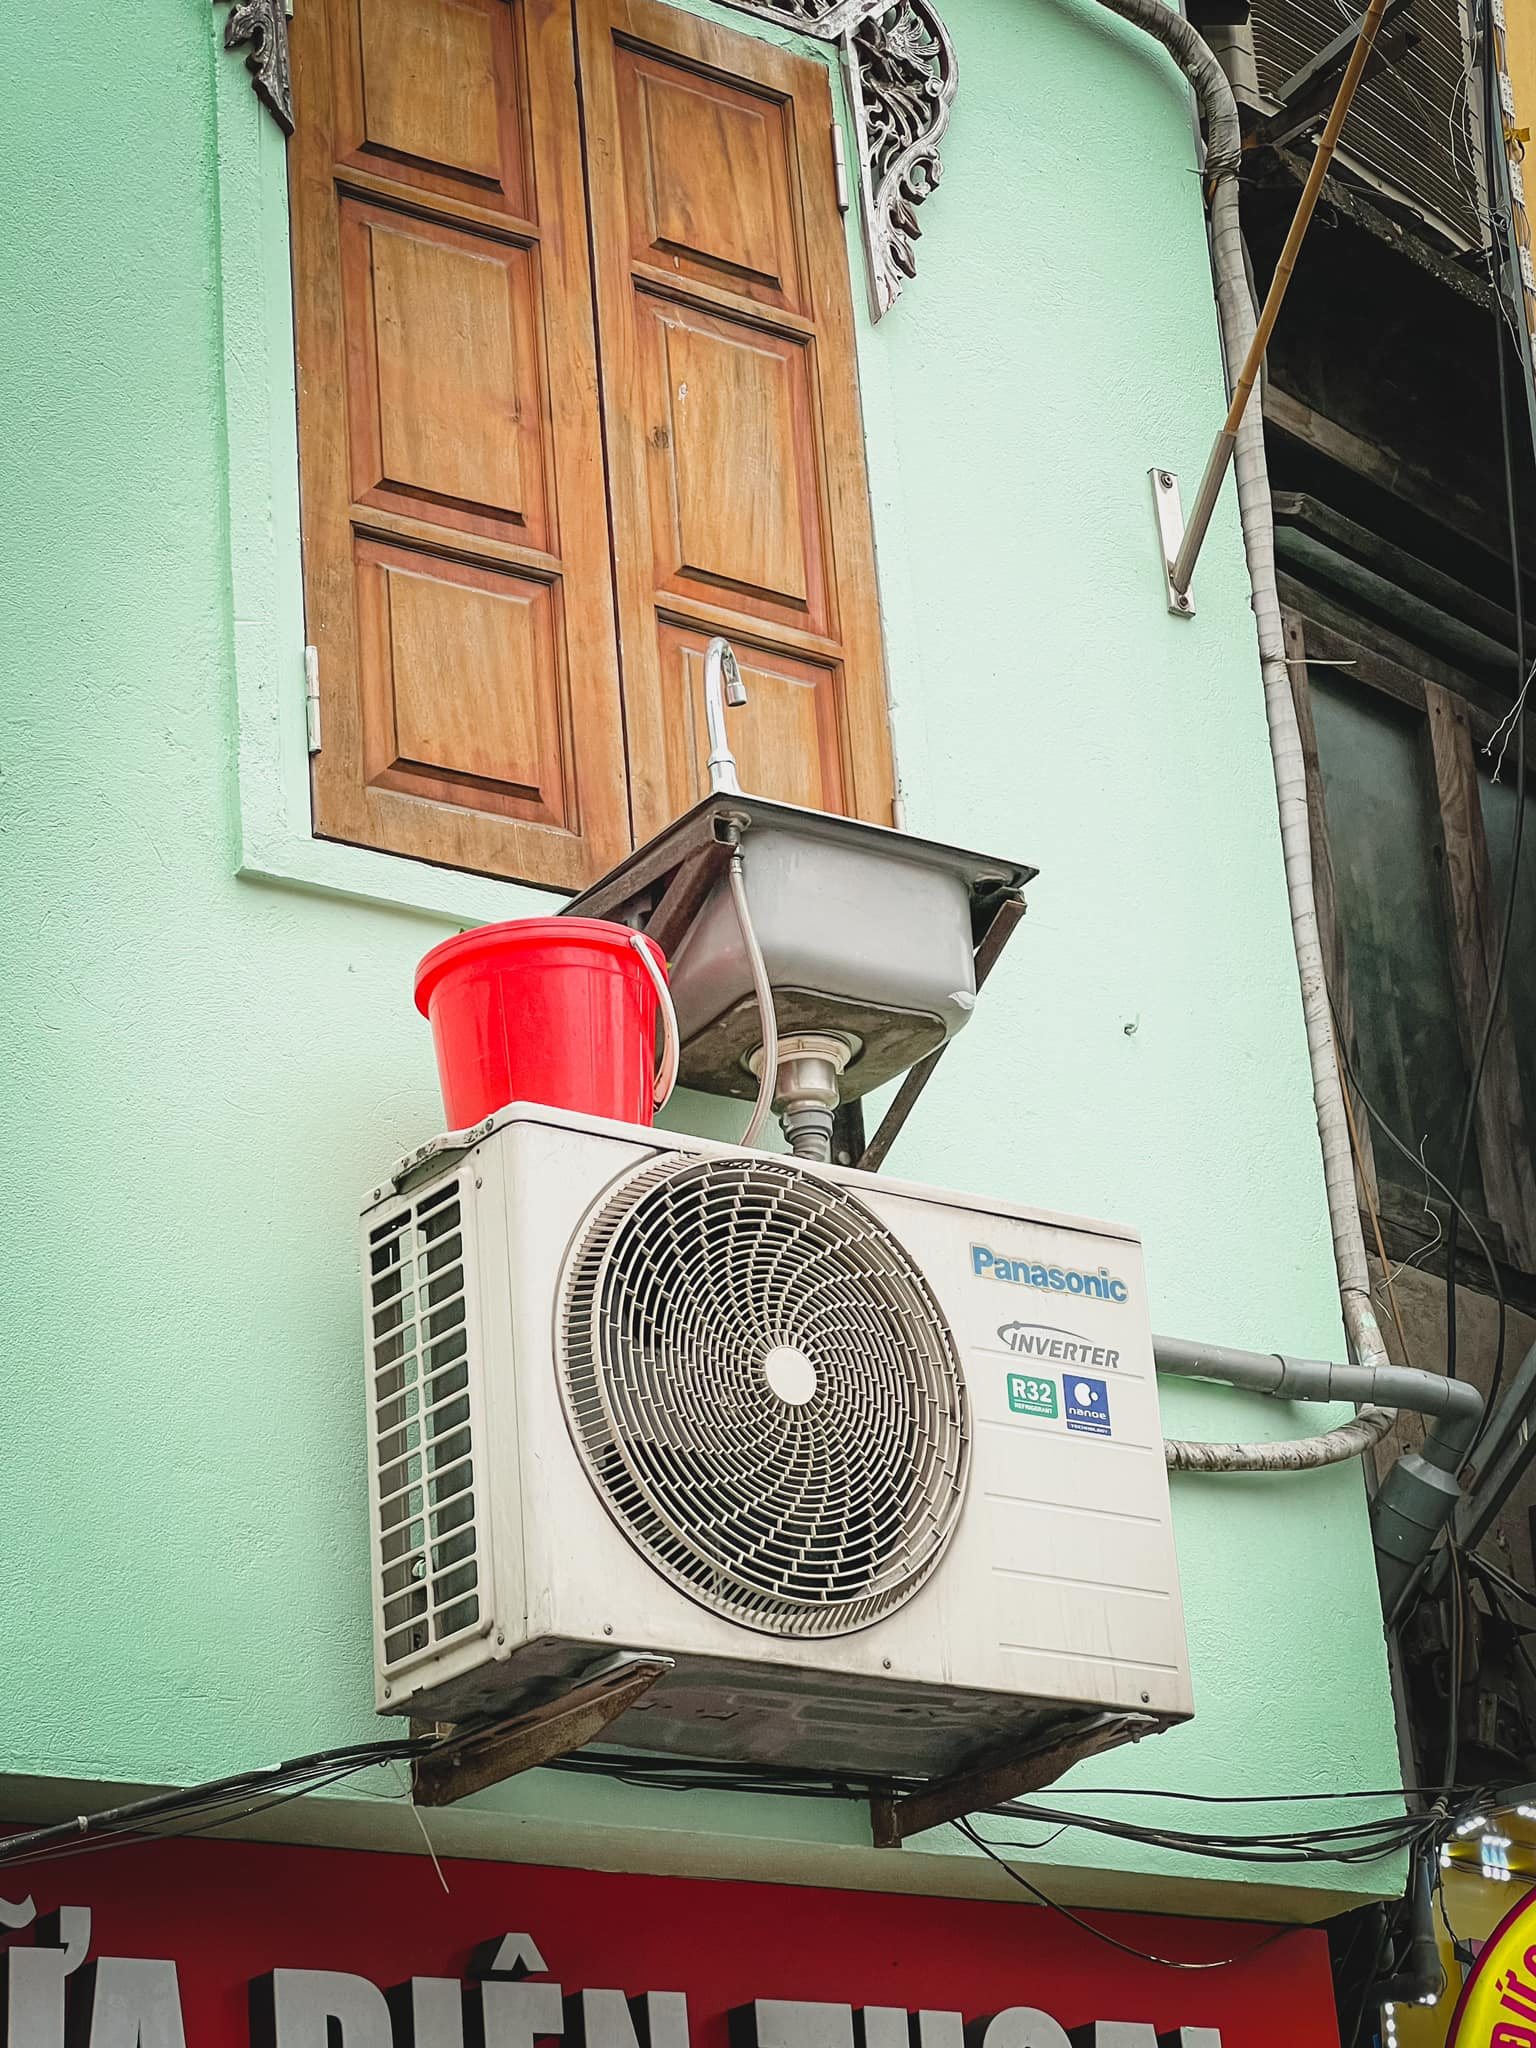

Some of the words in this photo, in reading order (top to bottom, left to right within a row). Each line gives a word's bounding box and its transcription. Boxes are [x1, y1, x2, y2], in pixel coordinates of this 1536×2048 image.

[972, 1245, 1128, 1302] Panasonic
[1009, 1332, 1120, 1369] INVERTER
[1011, 1377, 1053, 1403] R32
[1068, 1406, 1107, 1420] nanoe
